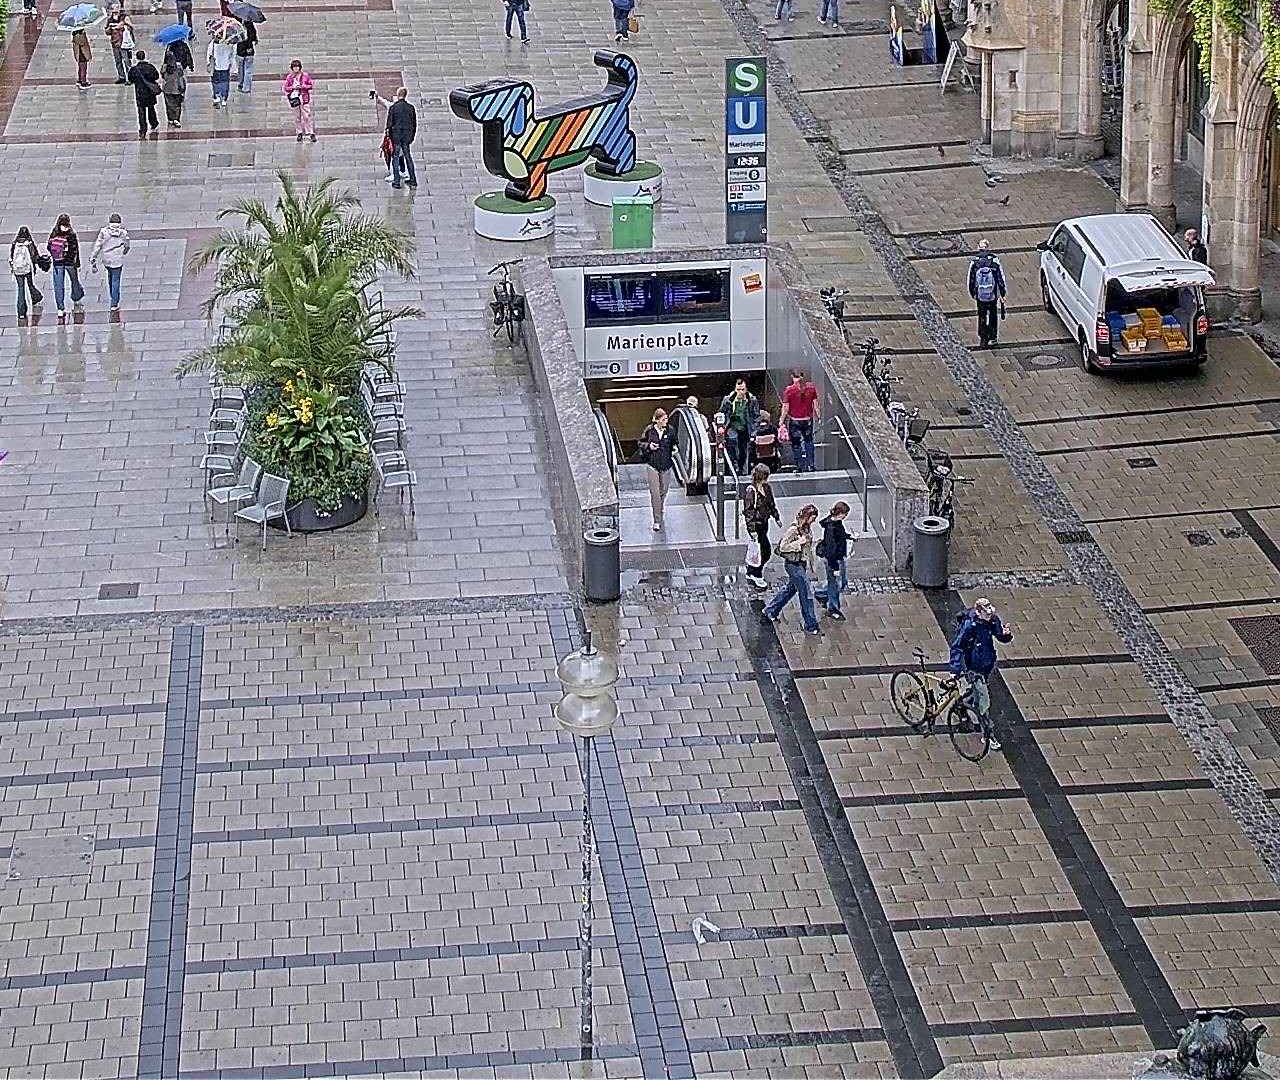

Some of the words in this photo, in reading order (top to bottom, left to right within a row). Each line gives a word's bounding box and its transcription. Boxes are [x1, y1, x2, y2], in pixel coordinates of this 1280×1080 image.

[735, 63, 759, 92] S
[735, 102, 758, 130] U
[729, 140, 765, 149] Marienplatz
[607, 332, 709, 351] Marienplatz
[612, 364, 619, 373] B
[639, 363, 651, 371] U3
[656, 362, 668, 370] U6
